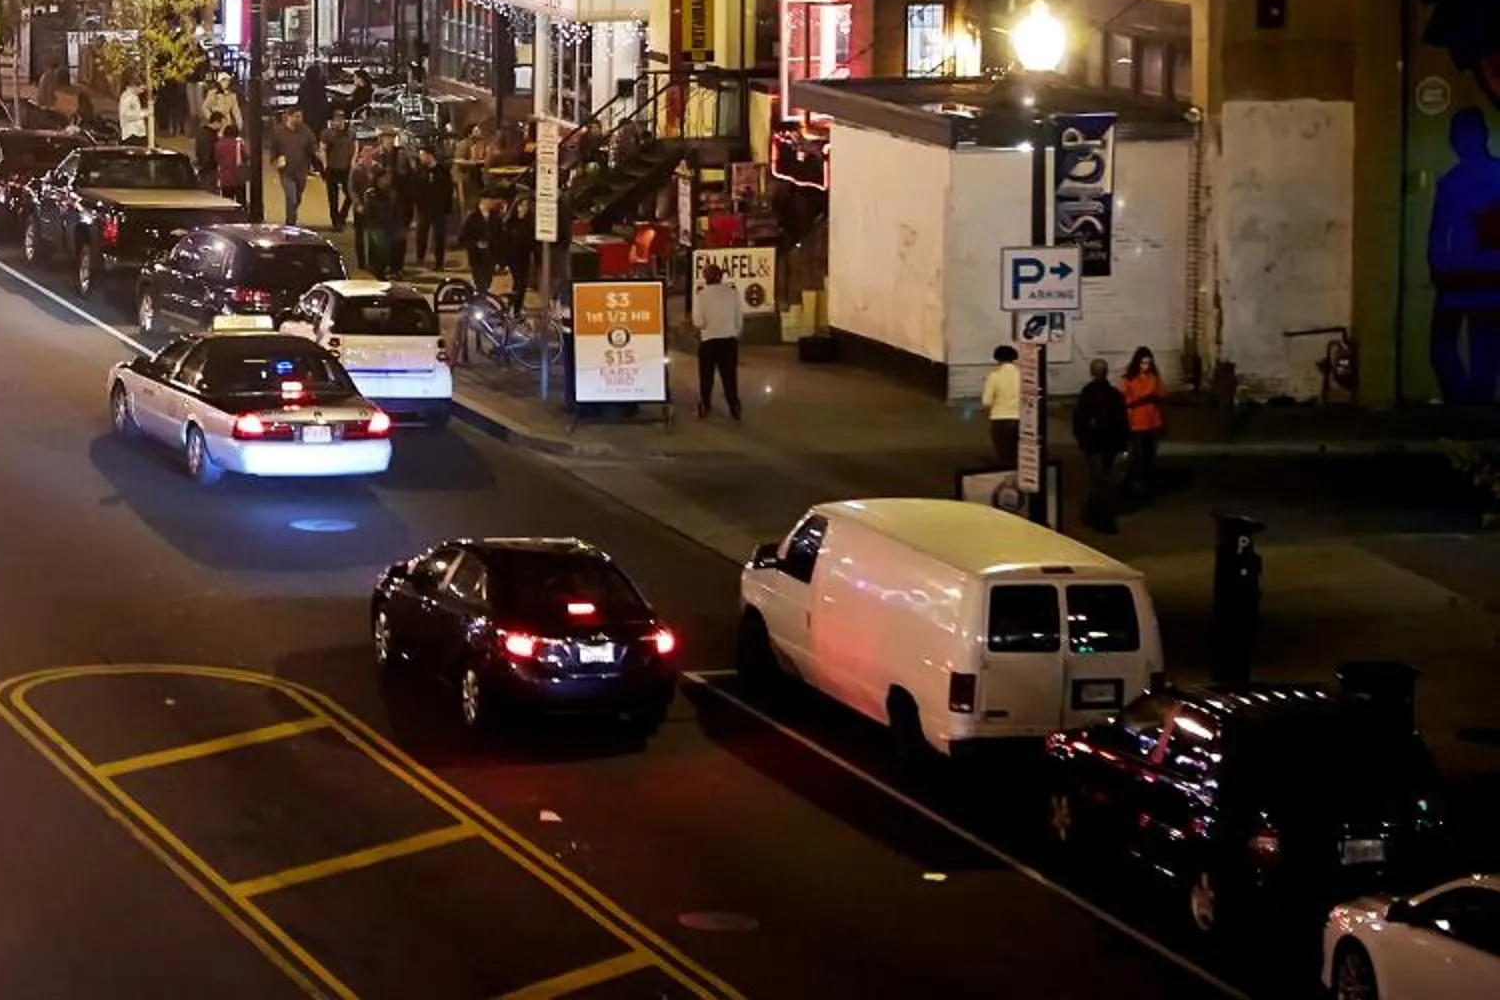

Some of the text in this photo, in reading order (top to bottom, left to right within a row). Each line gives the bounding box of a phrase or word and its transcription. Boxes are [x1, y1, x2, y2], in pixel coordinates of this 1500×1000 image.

[1057, 127, 1107, 235] SHOP
[605, 291, 631, 309] $3
[586, 312, 604, 323] 1st
[607, 311, 629, 324] 1/2
[604, 349, 636, 366] $15
[1237, 535, 1250, 555] P
